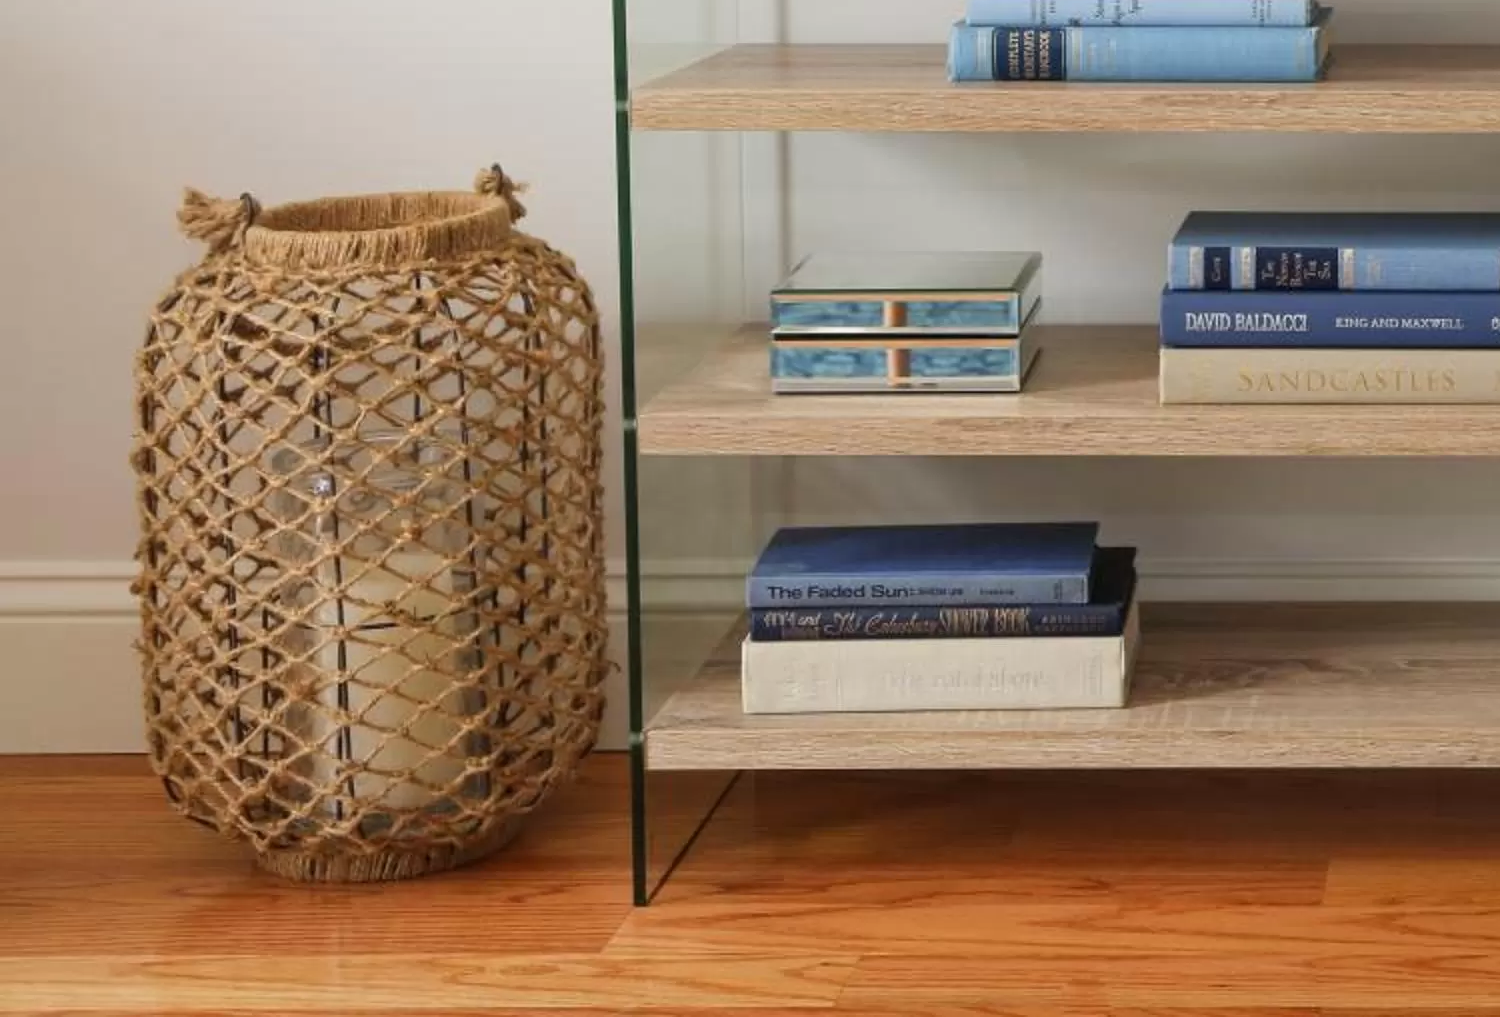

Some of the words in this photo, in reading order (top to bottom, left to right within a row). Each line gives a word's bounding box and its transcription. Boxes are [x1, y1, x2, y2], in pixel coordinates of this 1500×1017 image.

[1185, 312, 1231, 331] DAVID
[1234, 312, 1308, 331] BALDACCI
[1335, 316, 1368, 329] KING
[1370, 316, 1399, 329] AND
[1401, 316, 1464, 329] MAXWELL
[768, 585, 801, 600] The
[807, 584, 865, 599] Faded
